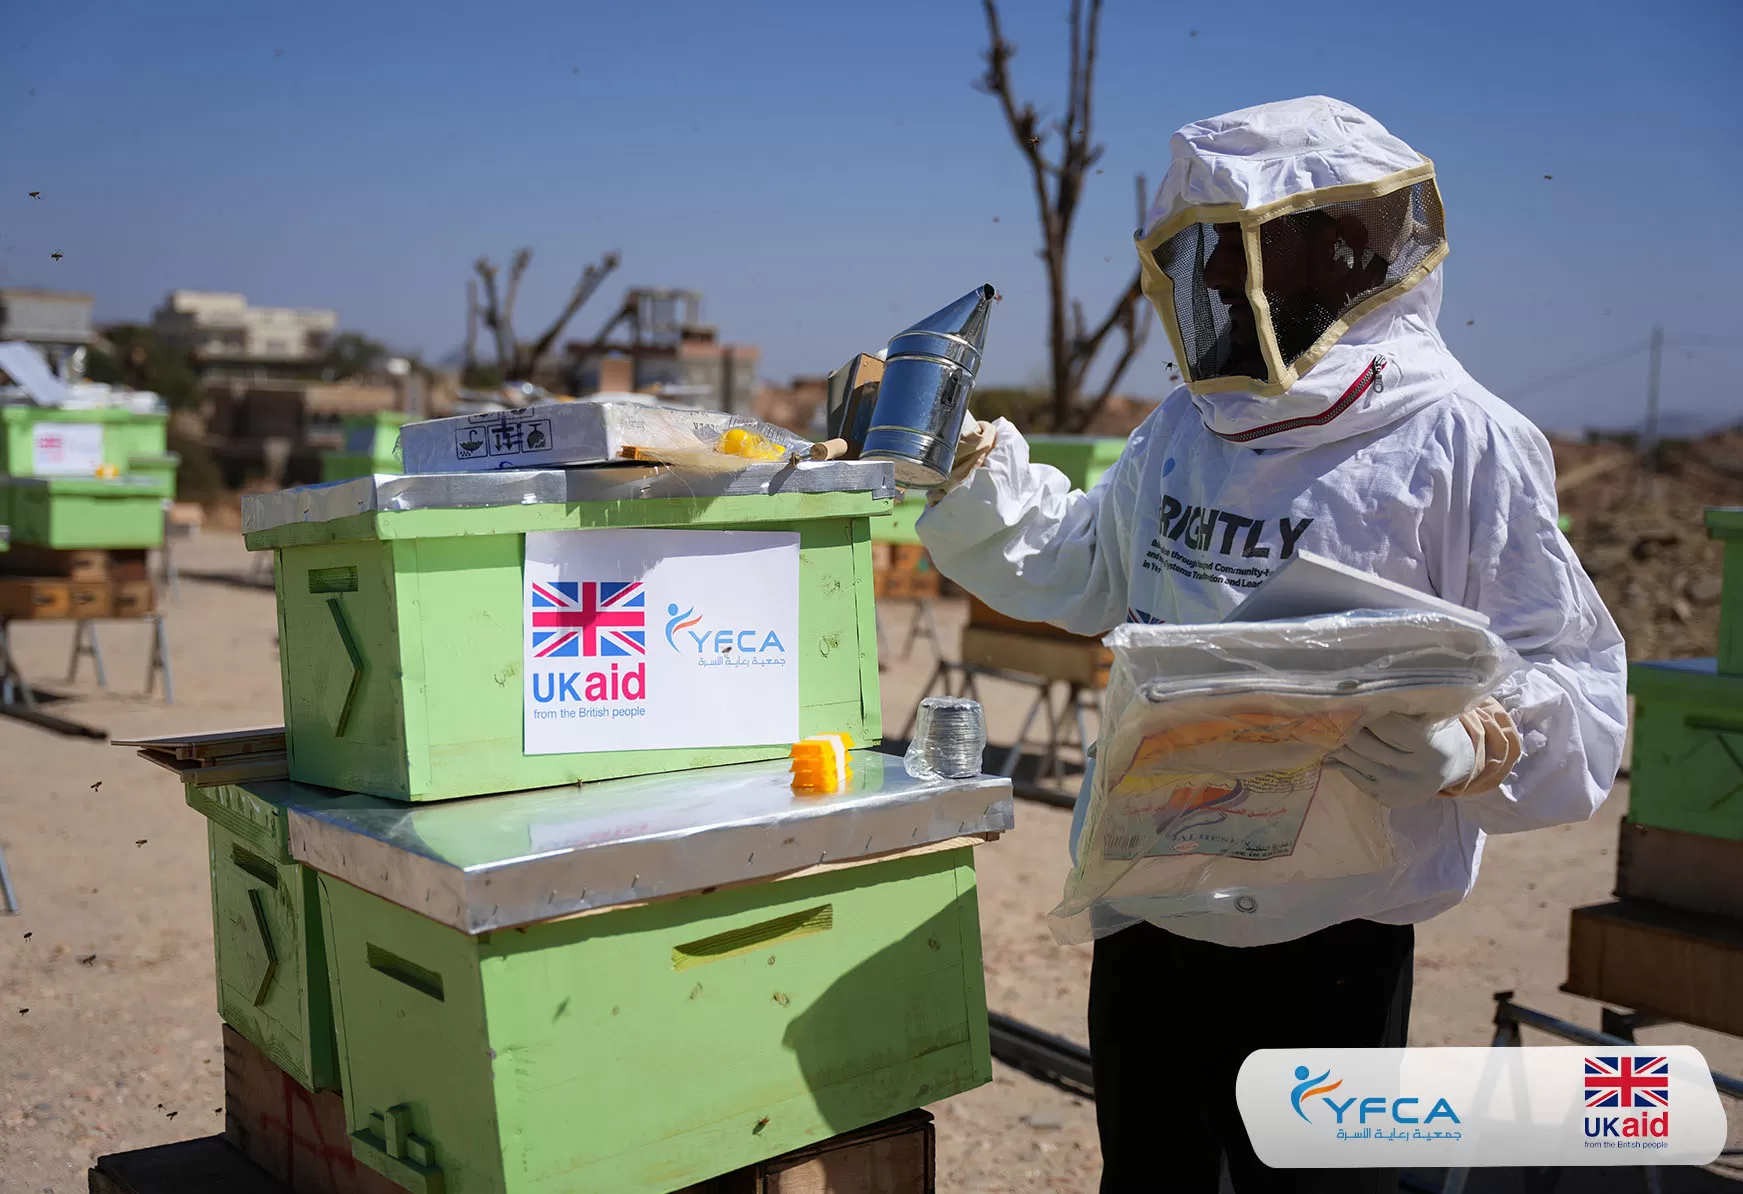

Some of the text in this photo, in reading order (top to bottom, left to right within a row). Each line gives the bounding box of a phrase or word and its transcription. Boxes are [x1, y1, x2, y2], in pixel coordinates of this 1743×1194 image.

[688, 630, 786, 653] YFCA
[533, 706, 646, 720] from the British people
